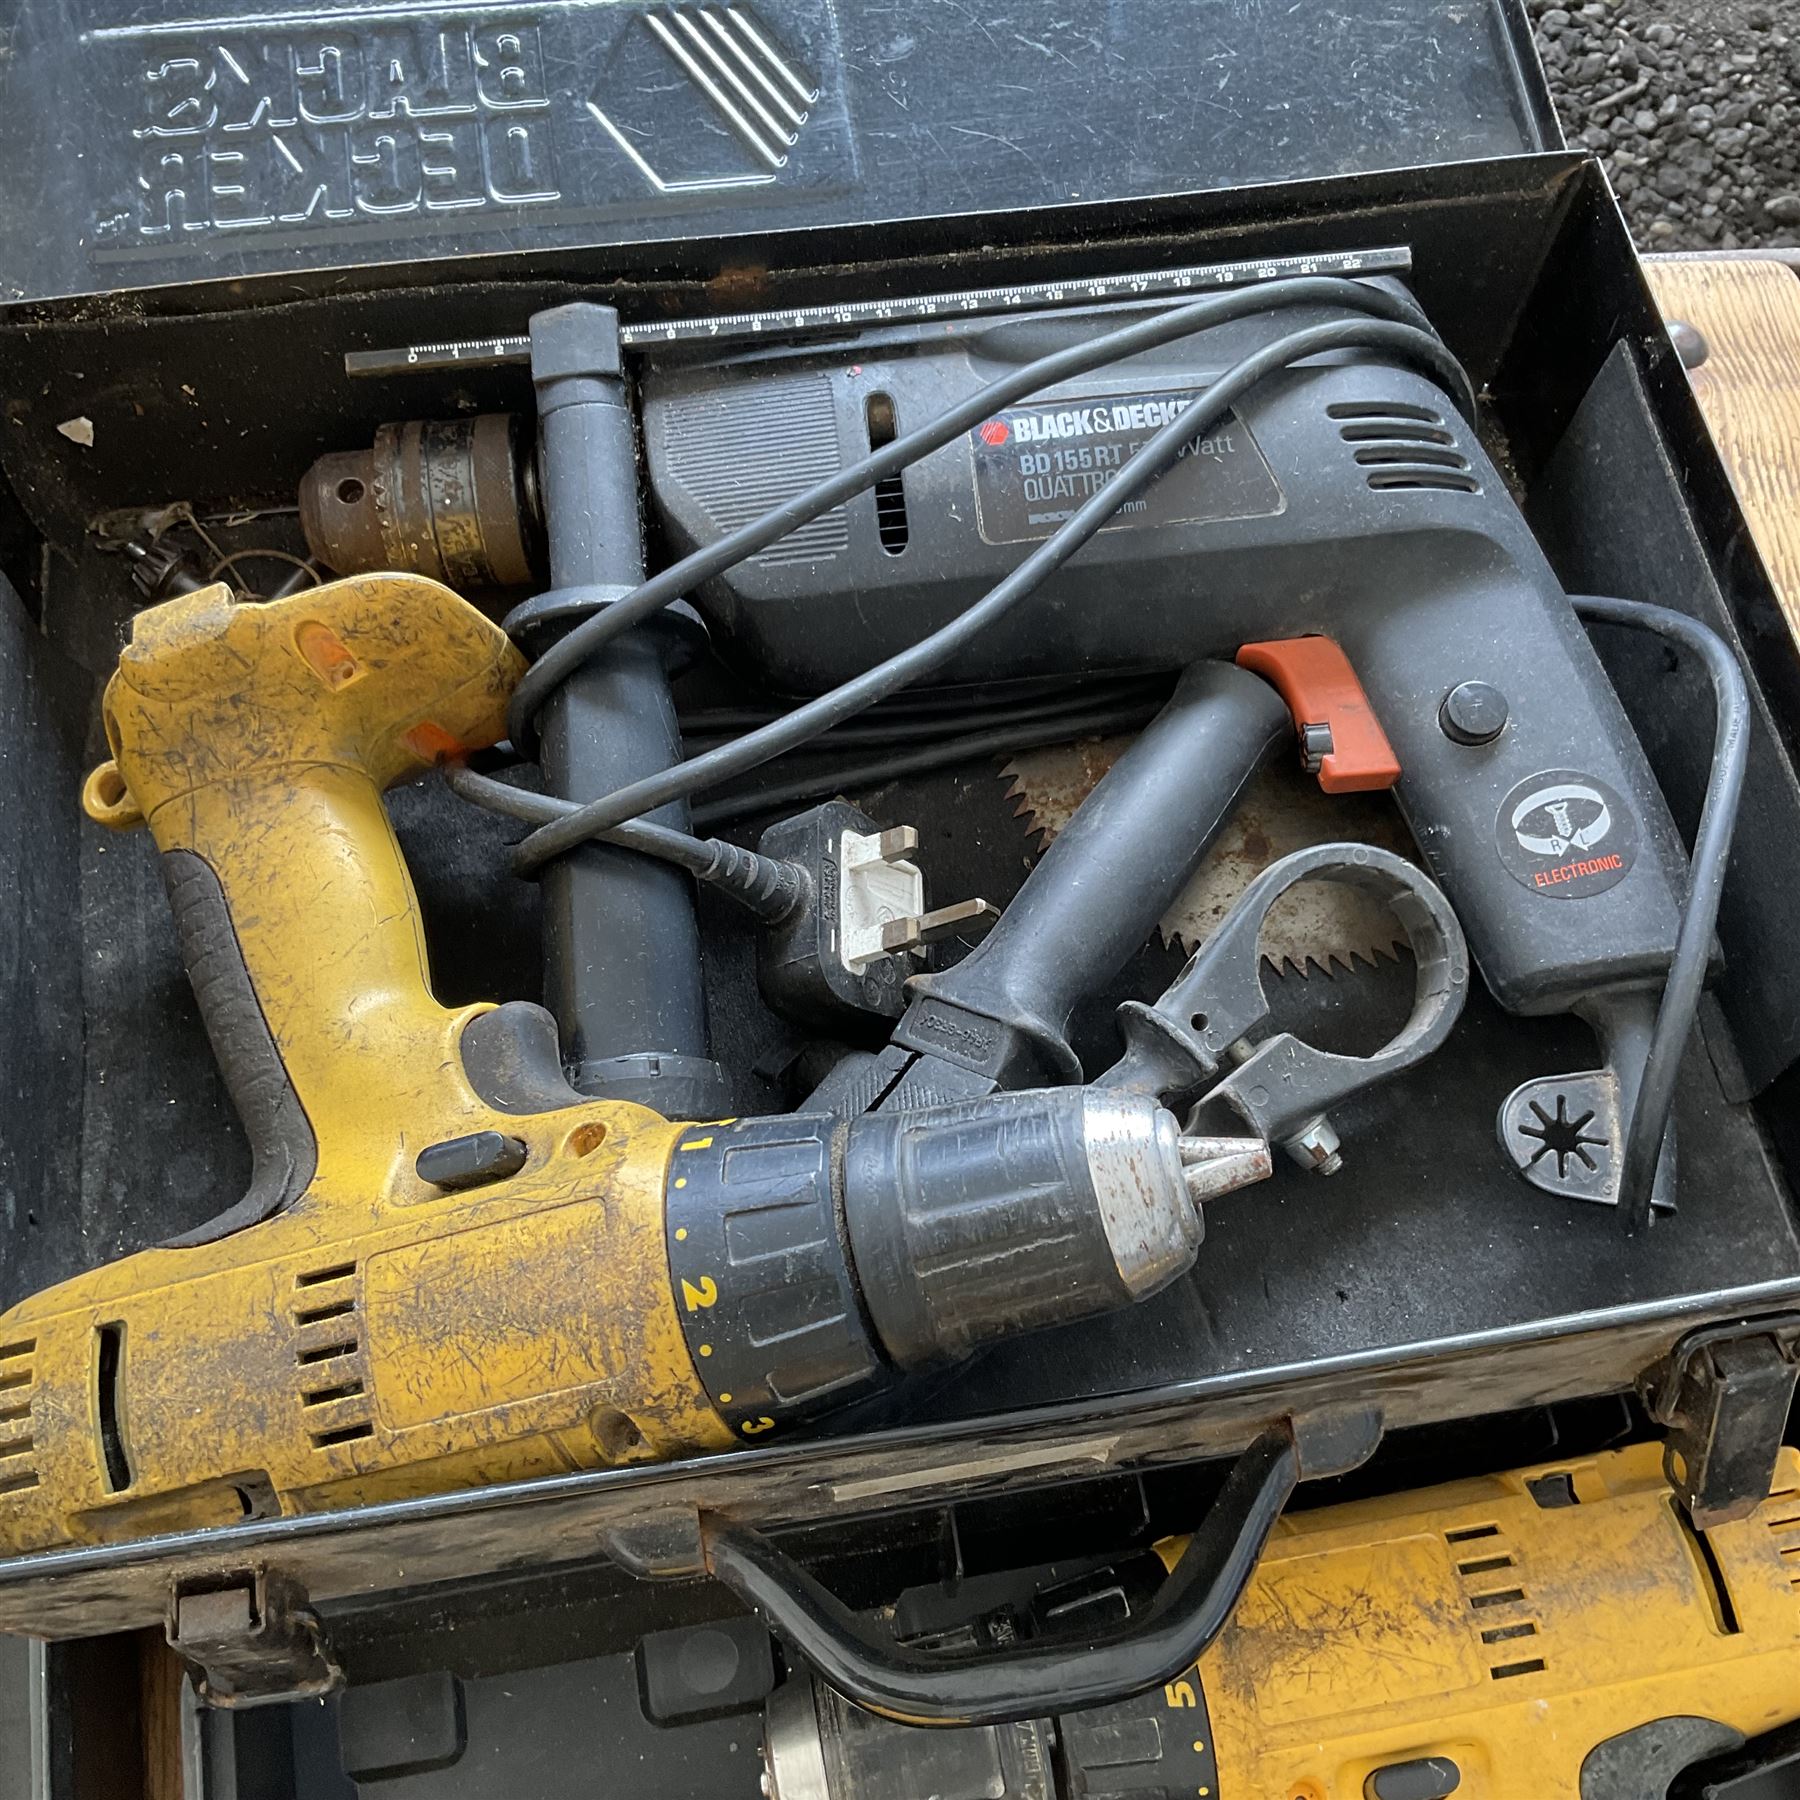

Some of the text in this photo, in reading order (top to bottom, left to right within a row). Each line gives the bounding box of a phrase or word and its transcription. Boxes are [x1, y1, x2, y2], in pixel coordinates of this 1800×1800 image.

[408, 353, 418, 362] 0
[452, 350, 459, 358] 1
[495, 346, 504, 355] 2
[709, 325, 718, 335] 7
[752, 321, 761, 331] 8
[795, 317, 804, 327] 9
[834, 312, 851, 322] 10
[876, 308, 892, 318] 11
[919, 304, 936, 314] 12
[960, 299, 978, 310] 13
[1003, 294, 1021, 305] 14
[1046, 290, 1063, 300] 15
[1088, 285, 1106, 296] 16
[1131, 281, 1148, 292] 17
[1173, 276, 1191, 287] 18
[1215, 272, 1233, 283] 19
[1258, 267, 1277, 278] 20
[1300, 262, 1318, 273] 21
[1342, 258, 1361, 269] 22
[1550, 833, 1590, 852] R L
[1534, 854, 1623, 888] ELECTRONIC
[681, 1275, 718, 1312] 2
[741, 1416, 775, 1434] 3
[1164, 1680, 1196, 1708] 5
